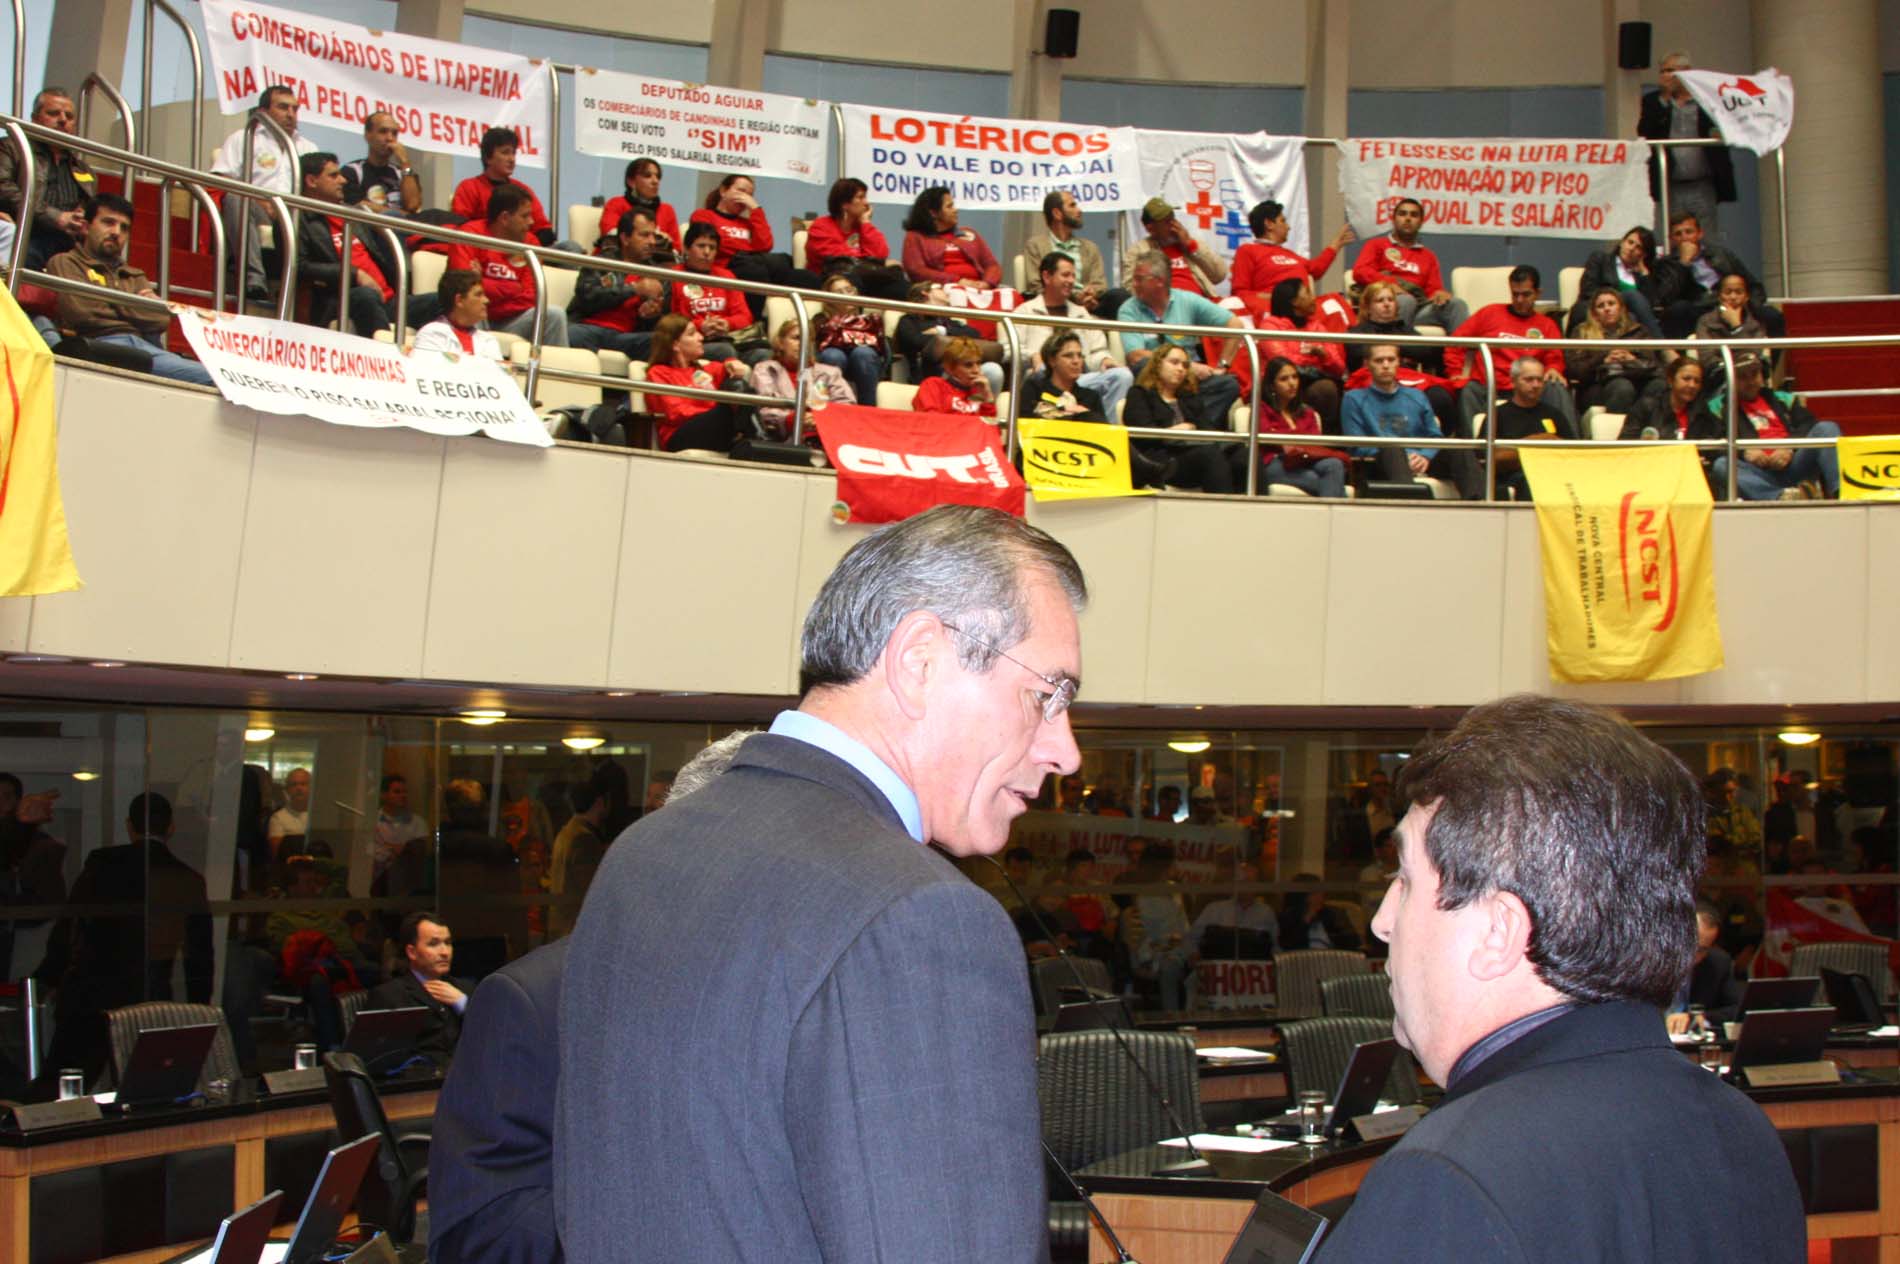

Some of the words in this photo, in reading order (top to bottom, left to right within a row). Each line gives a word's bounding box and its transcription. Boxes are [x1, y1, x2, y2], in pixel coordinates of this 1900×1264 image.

[231, 11, 395, 75] COMERCIÁRIOS
[401, 52, 429, 84] DE
[435, 57, 522, 101] ITAPEMA
[223, 66, 258, 101] NA
[316, 84, 370, 126] PELO
[429, 112, 539, 156] ESTAAL
[641, 83, 710, 104] DEPUTADO
[715, 94, 764, 111] AGUIAR
[583, 97, 596, 109] OS
[669, 109, 681, 122] DE
[739, 119, 745, 130] E
[784, 124, 820, 139] CONTAM
[598, 118, 618, 132] COM
[620, 121, 639, 134] SEU
[641, 123, 666, 138] VOTO
[870, 114, 1110, 157] LOTÉRICOS
[621, 141, 645, 155] PELO
[647, 145, 668, 159] PISO
[670, 148, 713, 164] SALARIAL
[716, 152, 762, 169] REGIONAL
[873, 148, 906, 166] DO
[916, 153, 980, 173] VALE
[990, 159, 1024, 176] DO
[1031, 154, 1114, 178] ITAJAÍ
[1481, 141, 1511, 163] NA
[1518, 143, 1569, 164] LUTA
[1575, 143, 1627, 165] PELA
[963, 181, 1000, 203] NOS
[1388, 163, 1502, 196] APROVAÇÃO
[1510, 170, 1535, 196] DO
[1540, 171, 1590, 196] PISO
[1376, 195, 1473, 225] ESTDUAL
[1479, 200, 1505, 226] DE
[203, 325, 306, 371] COMERCIÁRIOS
[310, 346, 327, 373] DE
[330, 347, 407, 384] CANOINHAS
[416, 378, 429, 396] E
[432, 379, 501, 401] REGIÃO
[294, 385, 310, 401] O
[312, 389, 353, 408] PISO
[837, 443, 979, 484] CUT
[1032, 448, 1097, 467] NCST
[1576, 529, 1585, 545] DE
[1589, 514, 1601, 548] NOVA
[1634, 508, 1663, 606] NCST
[1593, 550, 1605, 607] CENTRAL
